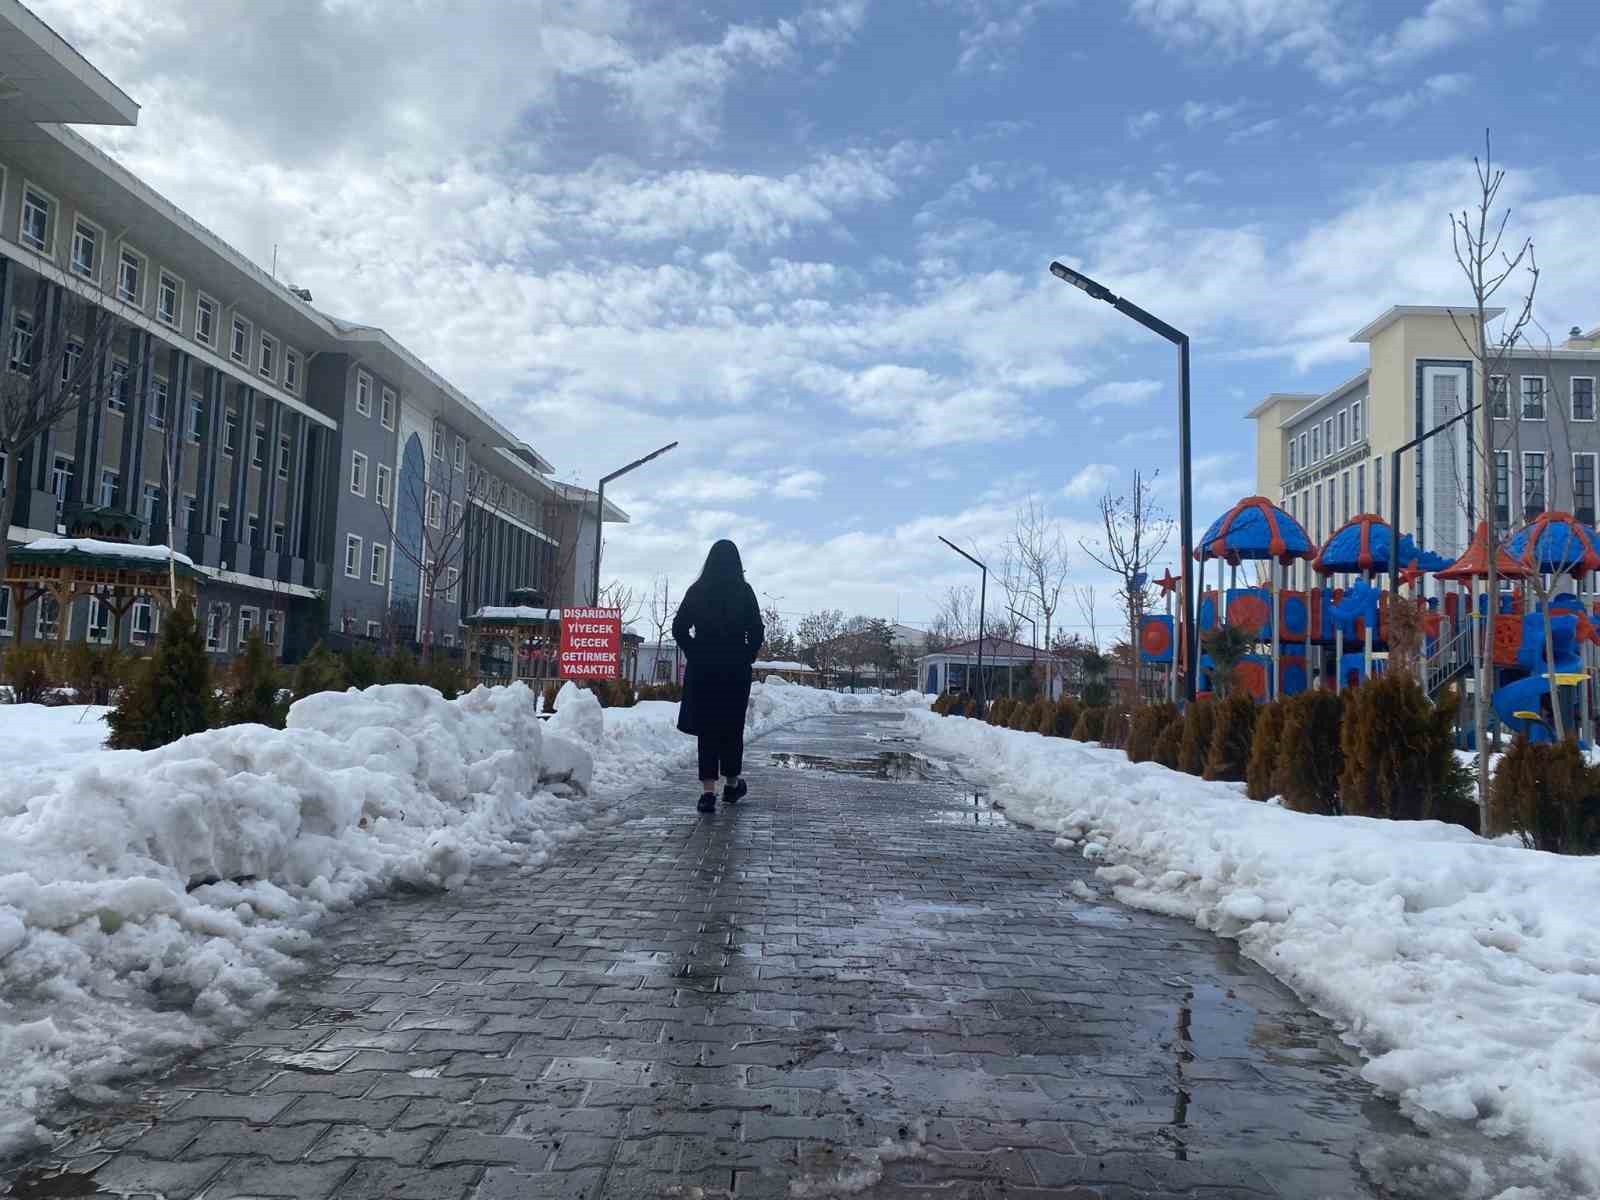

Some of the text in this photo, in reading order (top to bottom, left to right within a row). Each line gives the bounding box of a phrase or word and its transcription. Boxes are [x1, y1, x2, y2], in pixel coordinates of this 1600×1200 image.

[564, 609, 620, 620] DIŞARIDAN
[568, 622, 614, 633] YİYECEK
[570, 636, 609, 649] İÇECEK
[562, 650, 616, 662] GETİRMEK
[563, 665, 615, 674] YASAKTIR
